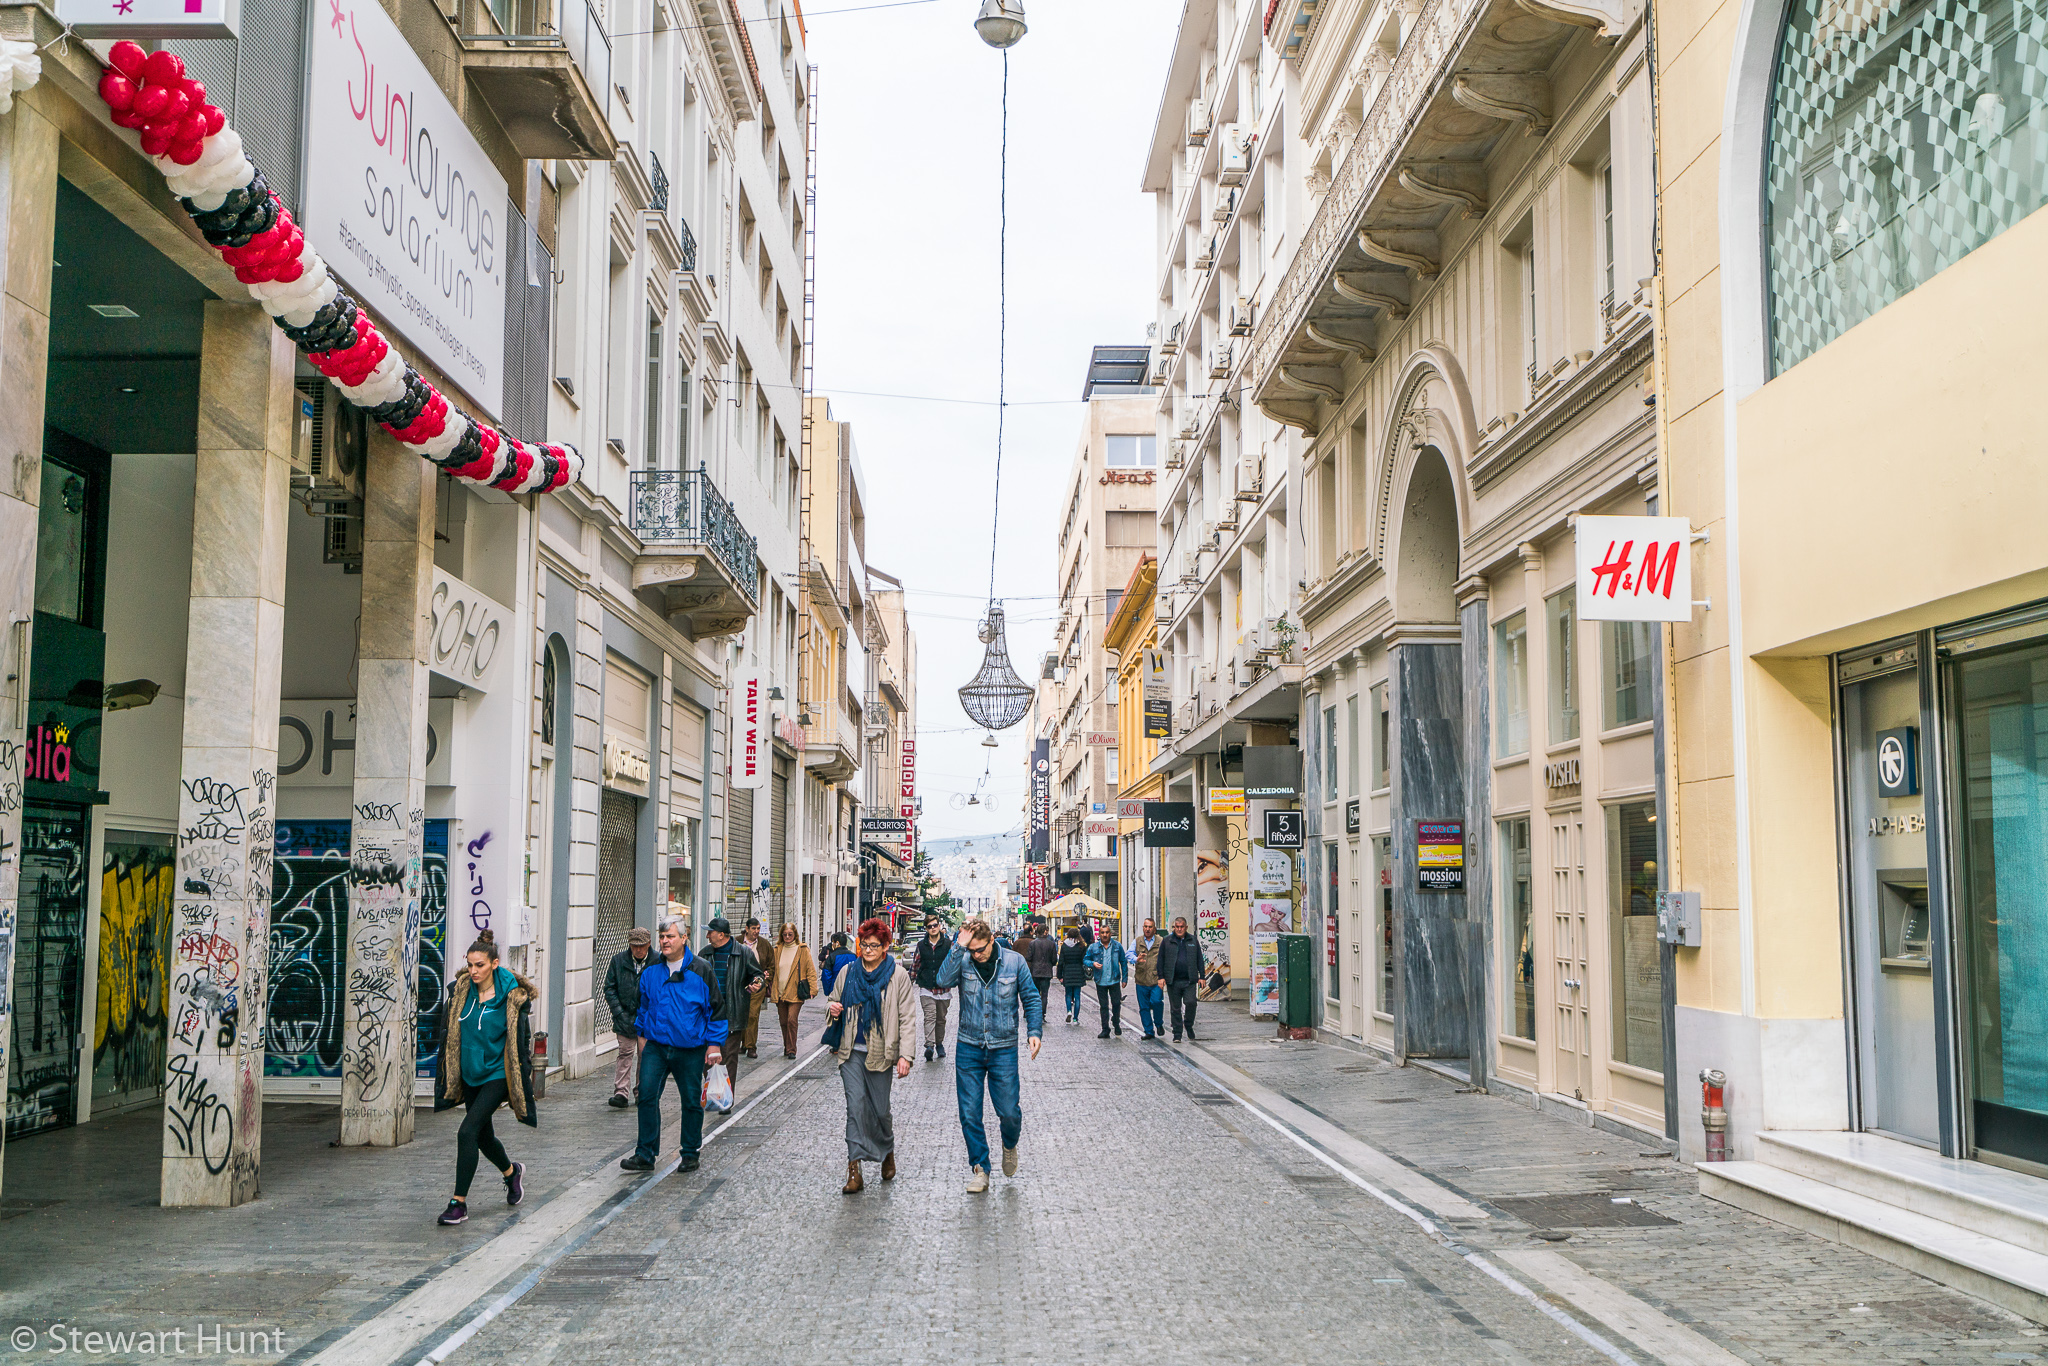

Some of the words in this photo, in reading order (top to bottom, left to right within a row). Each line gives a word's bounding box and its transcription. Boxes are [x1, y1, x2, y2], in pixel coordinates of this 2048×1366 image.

[339, 218, 373, 277] #tanning
[375, 255, 434, 331] #mystic_spraytan
[435, 317, 487, 385] #collagen_therapy
[1591, 540, 1680, 600] H&M
[747, 678, 757, 725] TALLY
[902, 741, 914, 797] BODY
[1246, 787, 1295, 795] CALZEDONIA
[1543, 759, 1581, 789] OYSHO
[1036, 775, 1045, 831] ZAKCRET
[1271, 831, 1298, 844] fiftysix
[1420, 868, 1461, 882] mossiou
